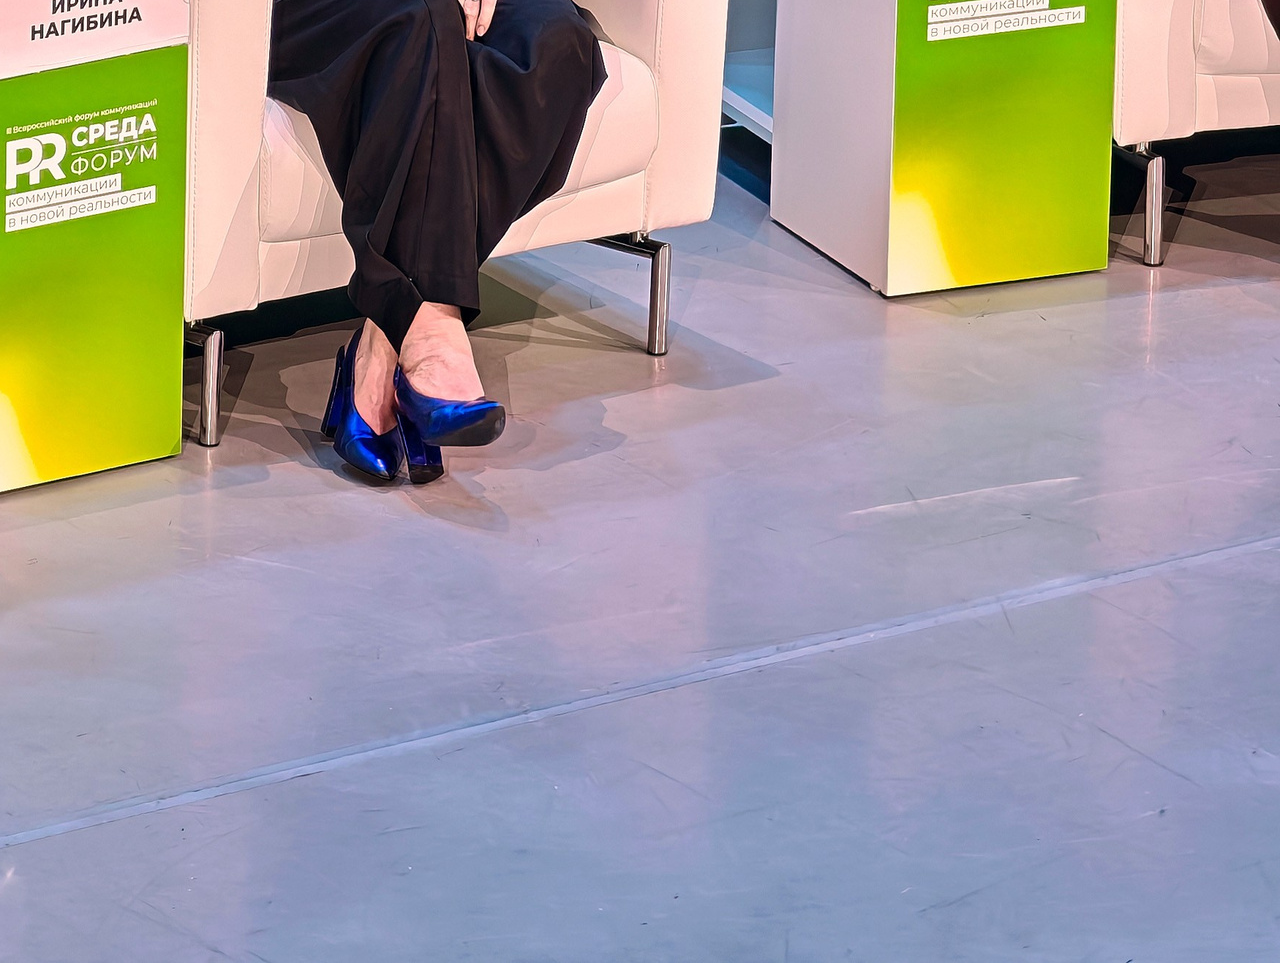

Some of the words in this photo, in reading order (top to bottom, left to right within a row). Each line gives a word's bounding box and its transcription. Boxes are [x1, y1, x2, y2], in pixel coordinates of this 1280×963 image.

[31, 7, 142, 40] НАГИБИНА
[931, 25, 938, 37] в
[943, 19, 989, 36] новой
[994, 10, 1081, 32] реальности
[13, 116, 73, 133] Всероссийский
[74, 111, 99, 123] форум
[101, 98, 157, 116] коммуникаций
[72, 113, 157, 147] СРЕДА
[6, 133, 66, 190] PR
[71, 142, 157, 176] ФОРУМ
[9, 178, 117, 208] коммуникации
[9, 218, 16, 228] в
[20, 206, 64, 226] новой
[70, 190, 152, 219] реальности
